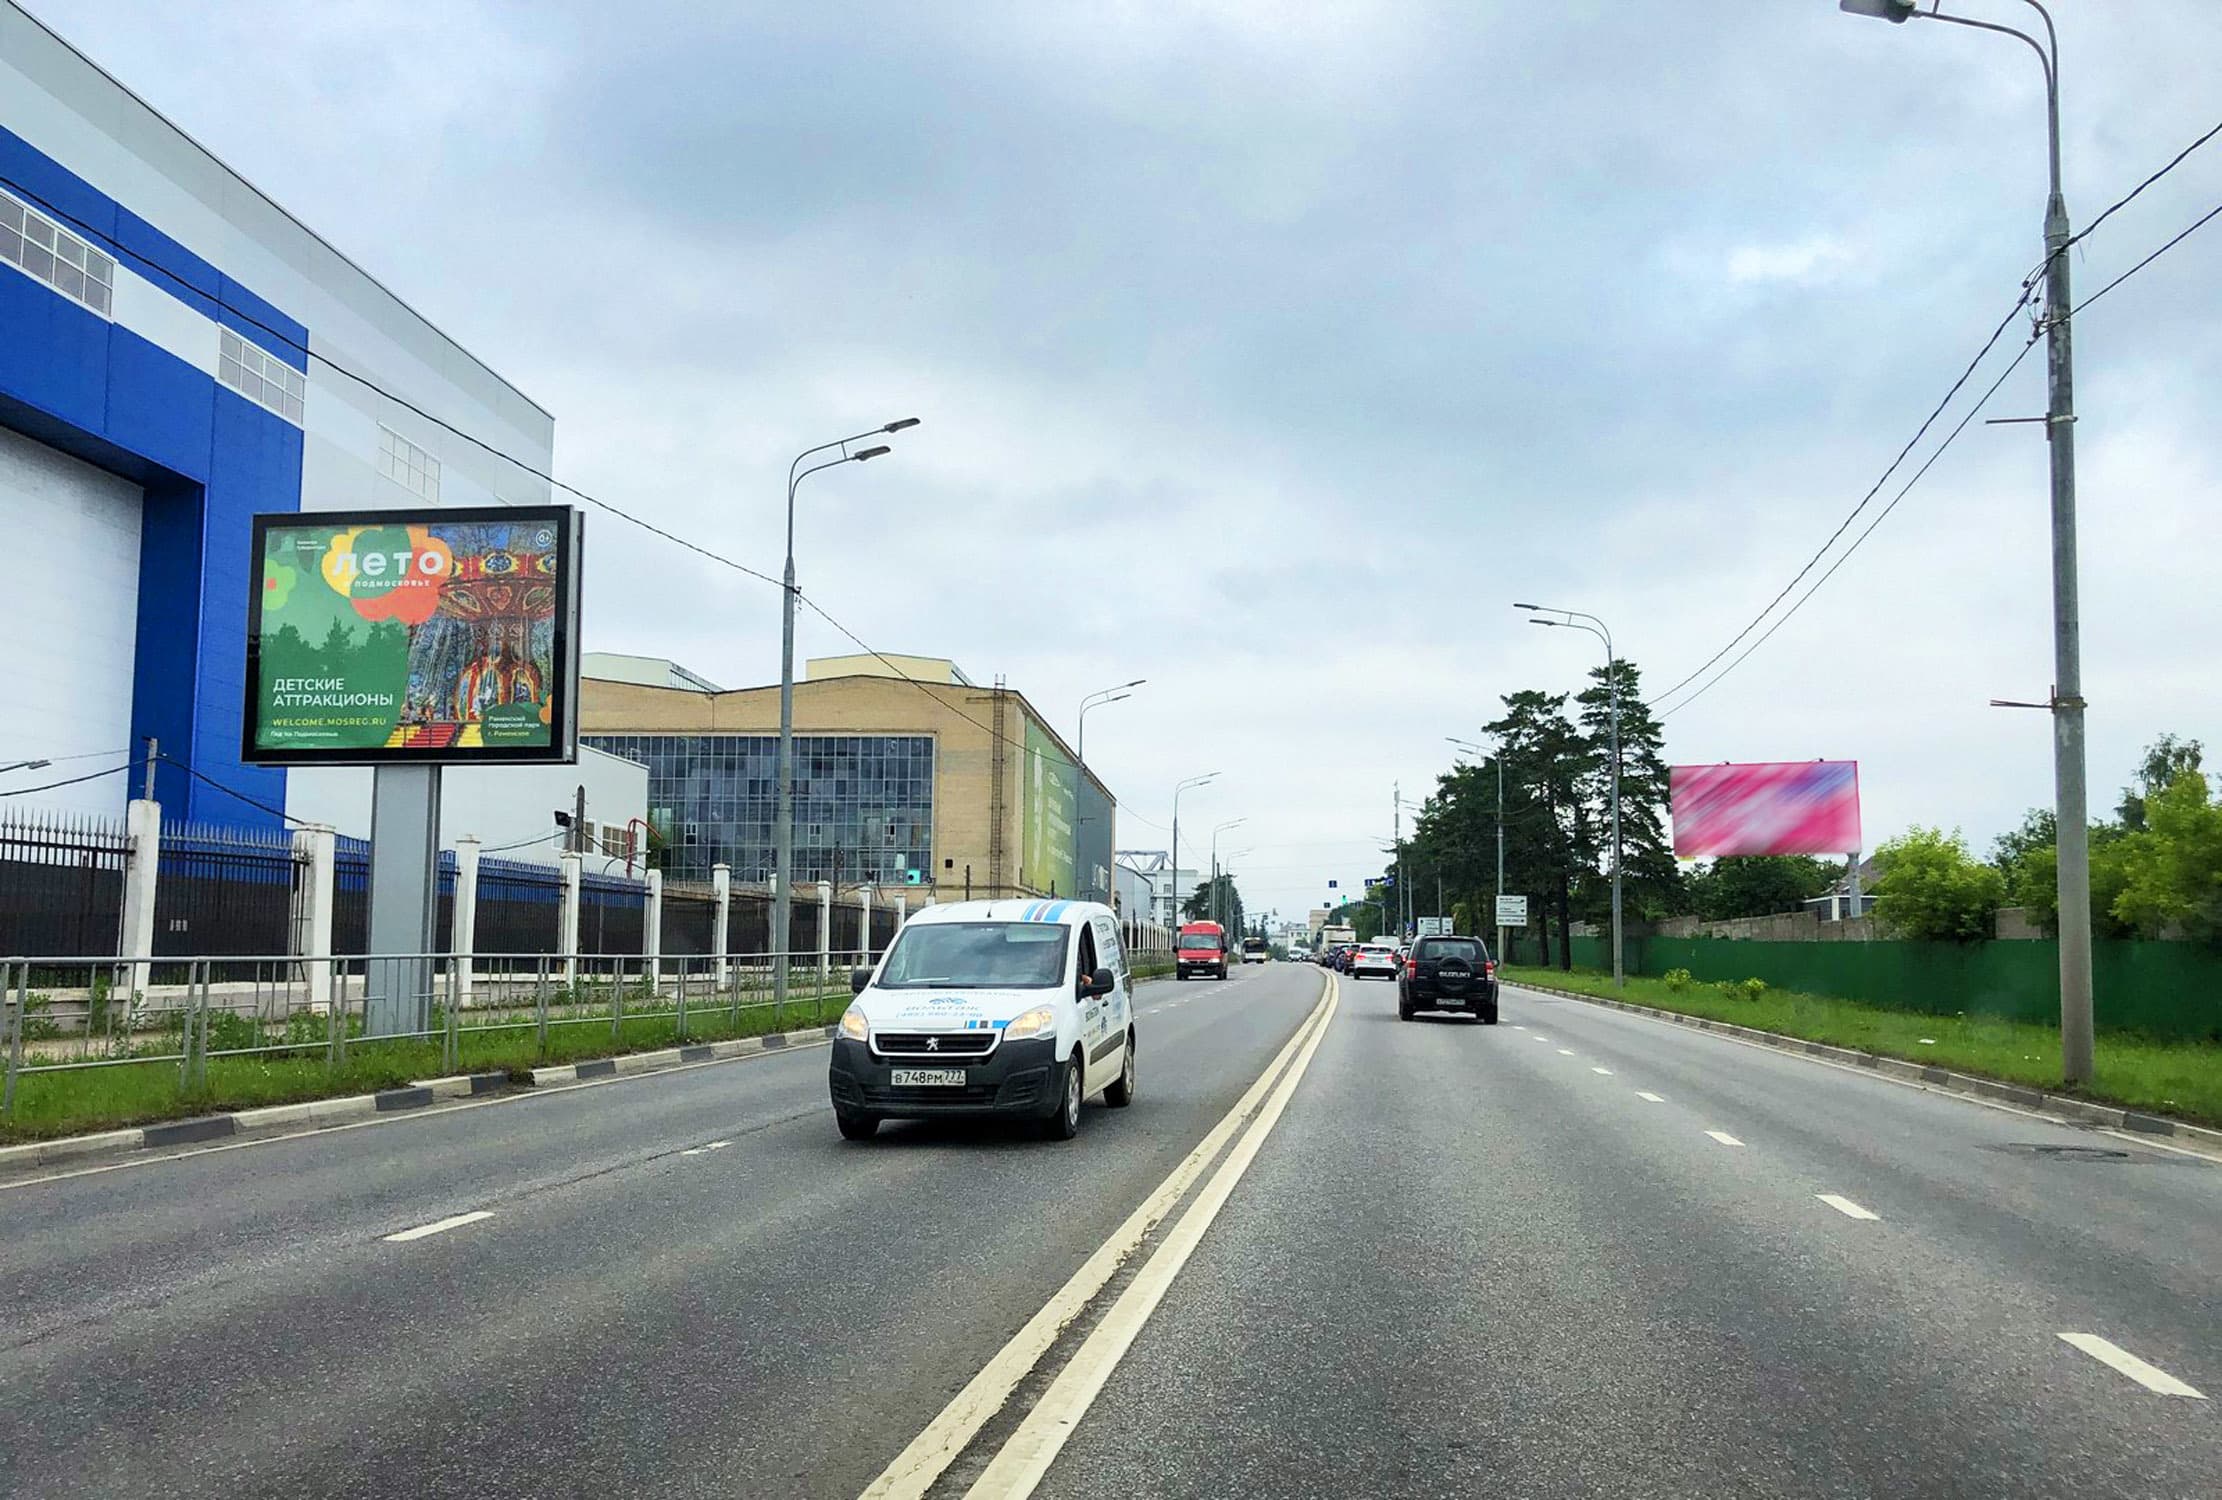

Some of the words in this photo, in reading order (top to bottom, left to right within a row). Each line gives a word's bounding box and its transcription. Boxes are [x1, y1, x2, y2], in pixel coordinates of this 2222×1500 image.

[272, 678, 345, 693] ДЕТСКИЕ
[272, 693, 394, 708] АТТРАКЦИОНЫ
[272, 717, 387, 727] WELCOME.MOSREG.RU
